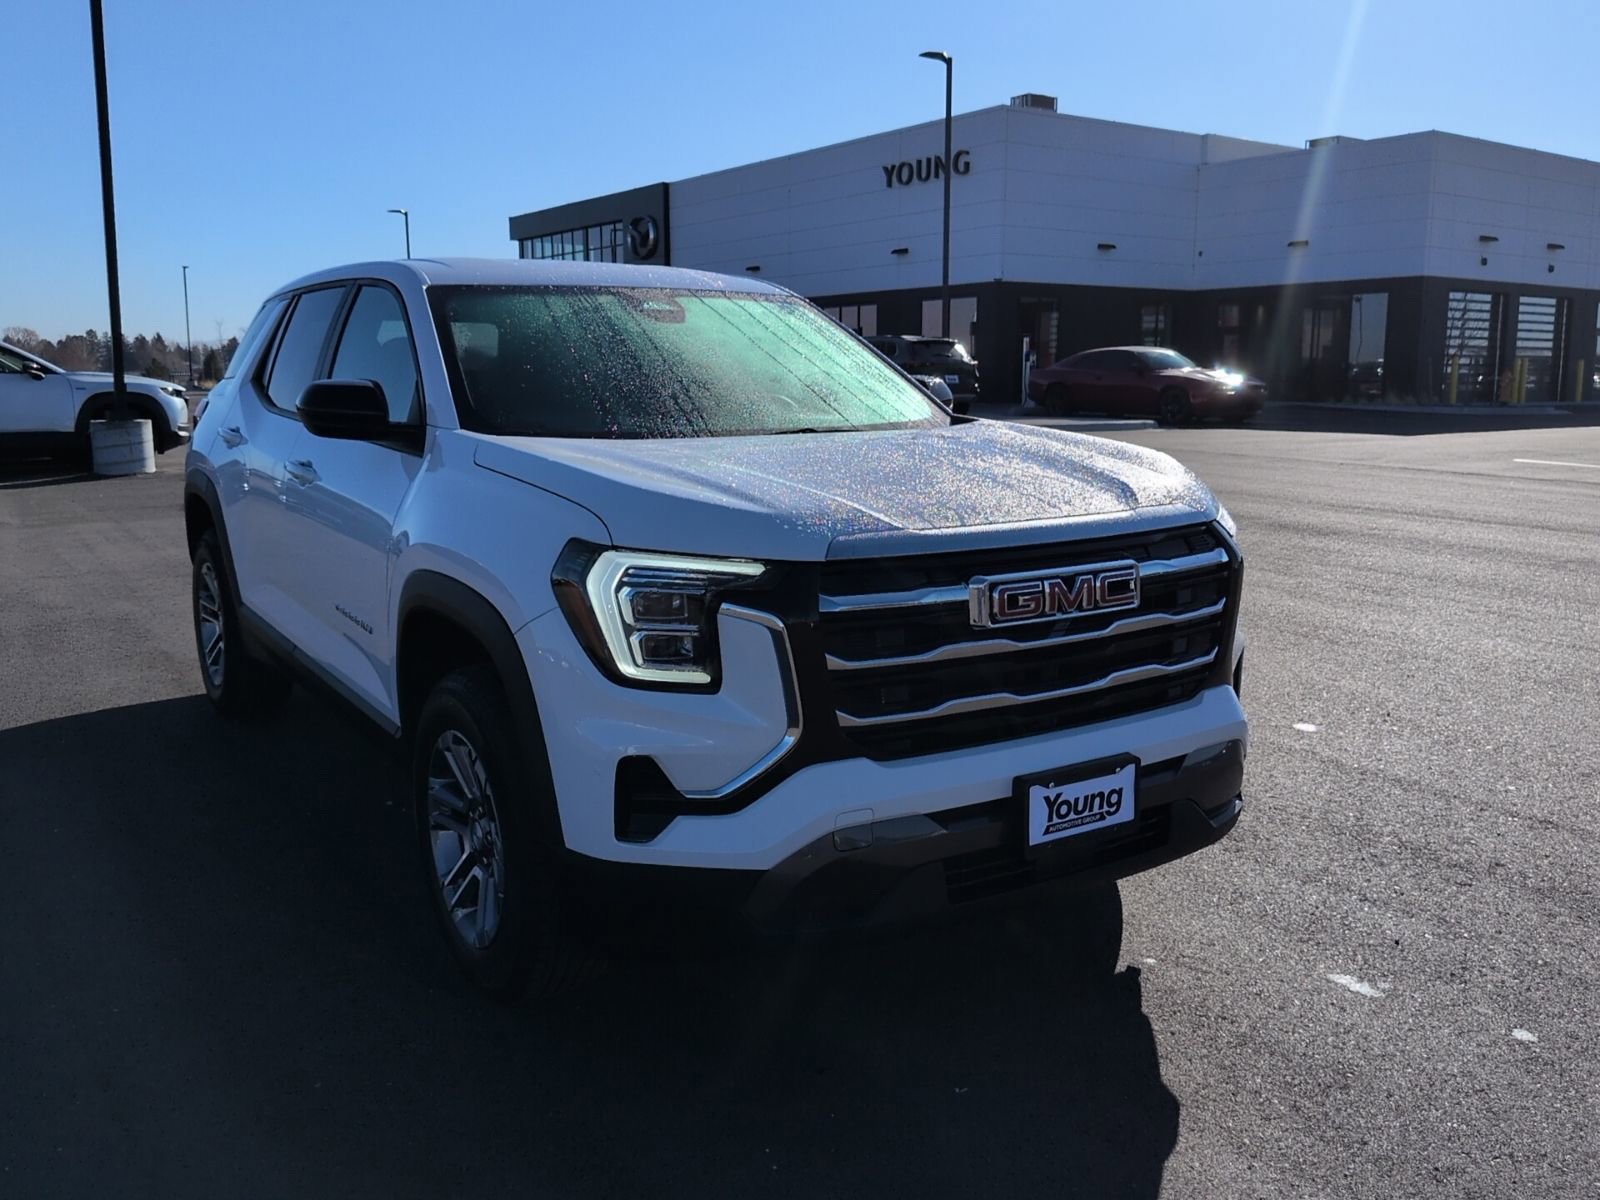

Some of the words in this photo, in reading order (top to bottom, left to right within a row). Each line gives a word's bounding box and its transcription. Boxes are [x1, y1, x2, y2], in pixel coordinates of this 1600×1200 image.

[882, 150, 970, 188] YOUNG
[993, 569, 1137, 620] GMC
[1043, 787, 1123, 823] Young
[1049, 819, 1082, 832] AUTOMOTIVE
[1083, 815, 1101, 824] GROUP
